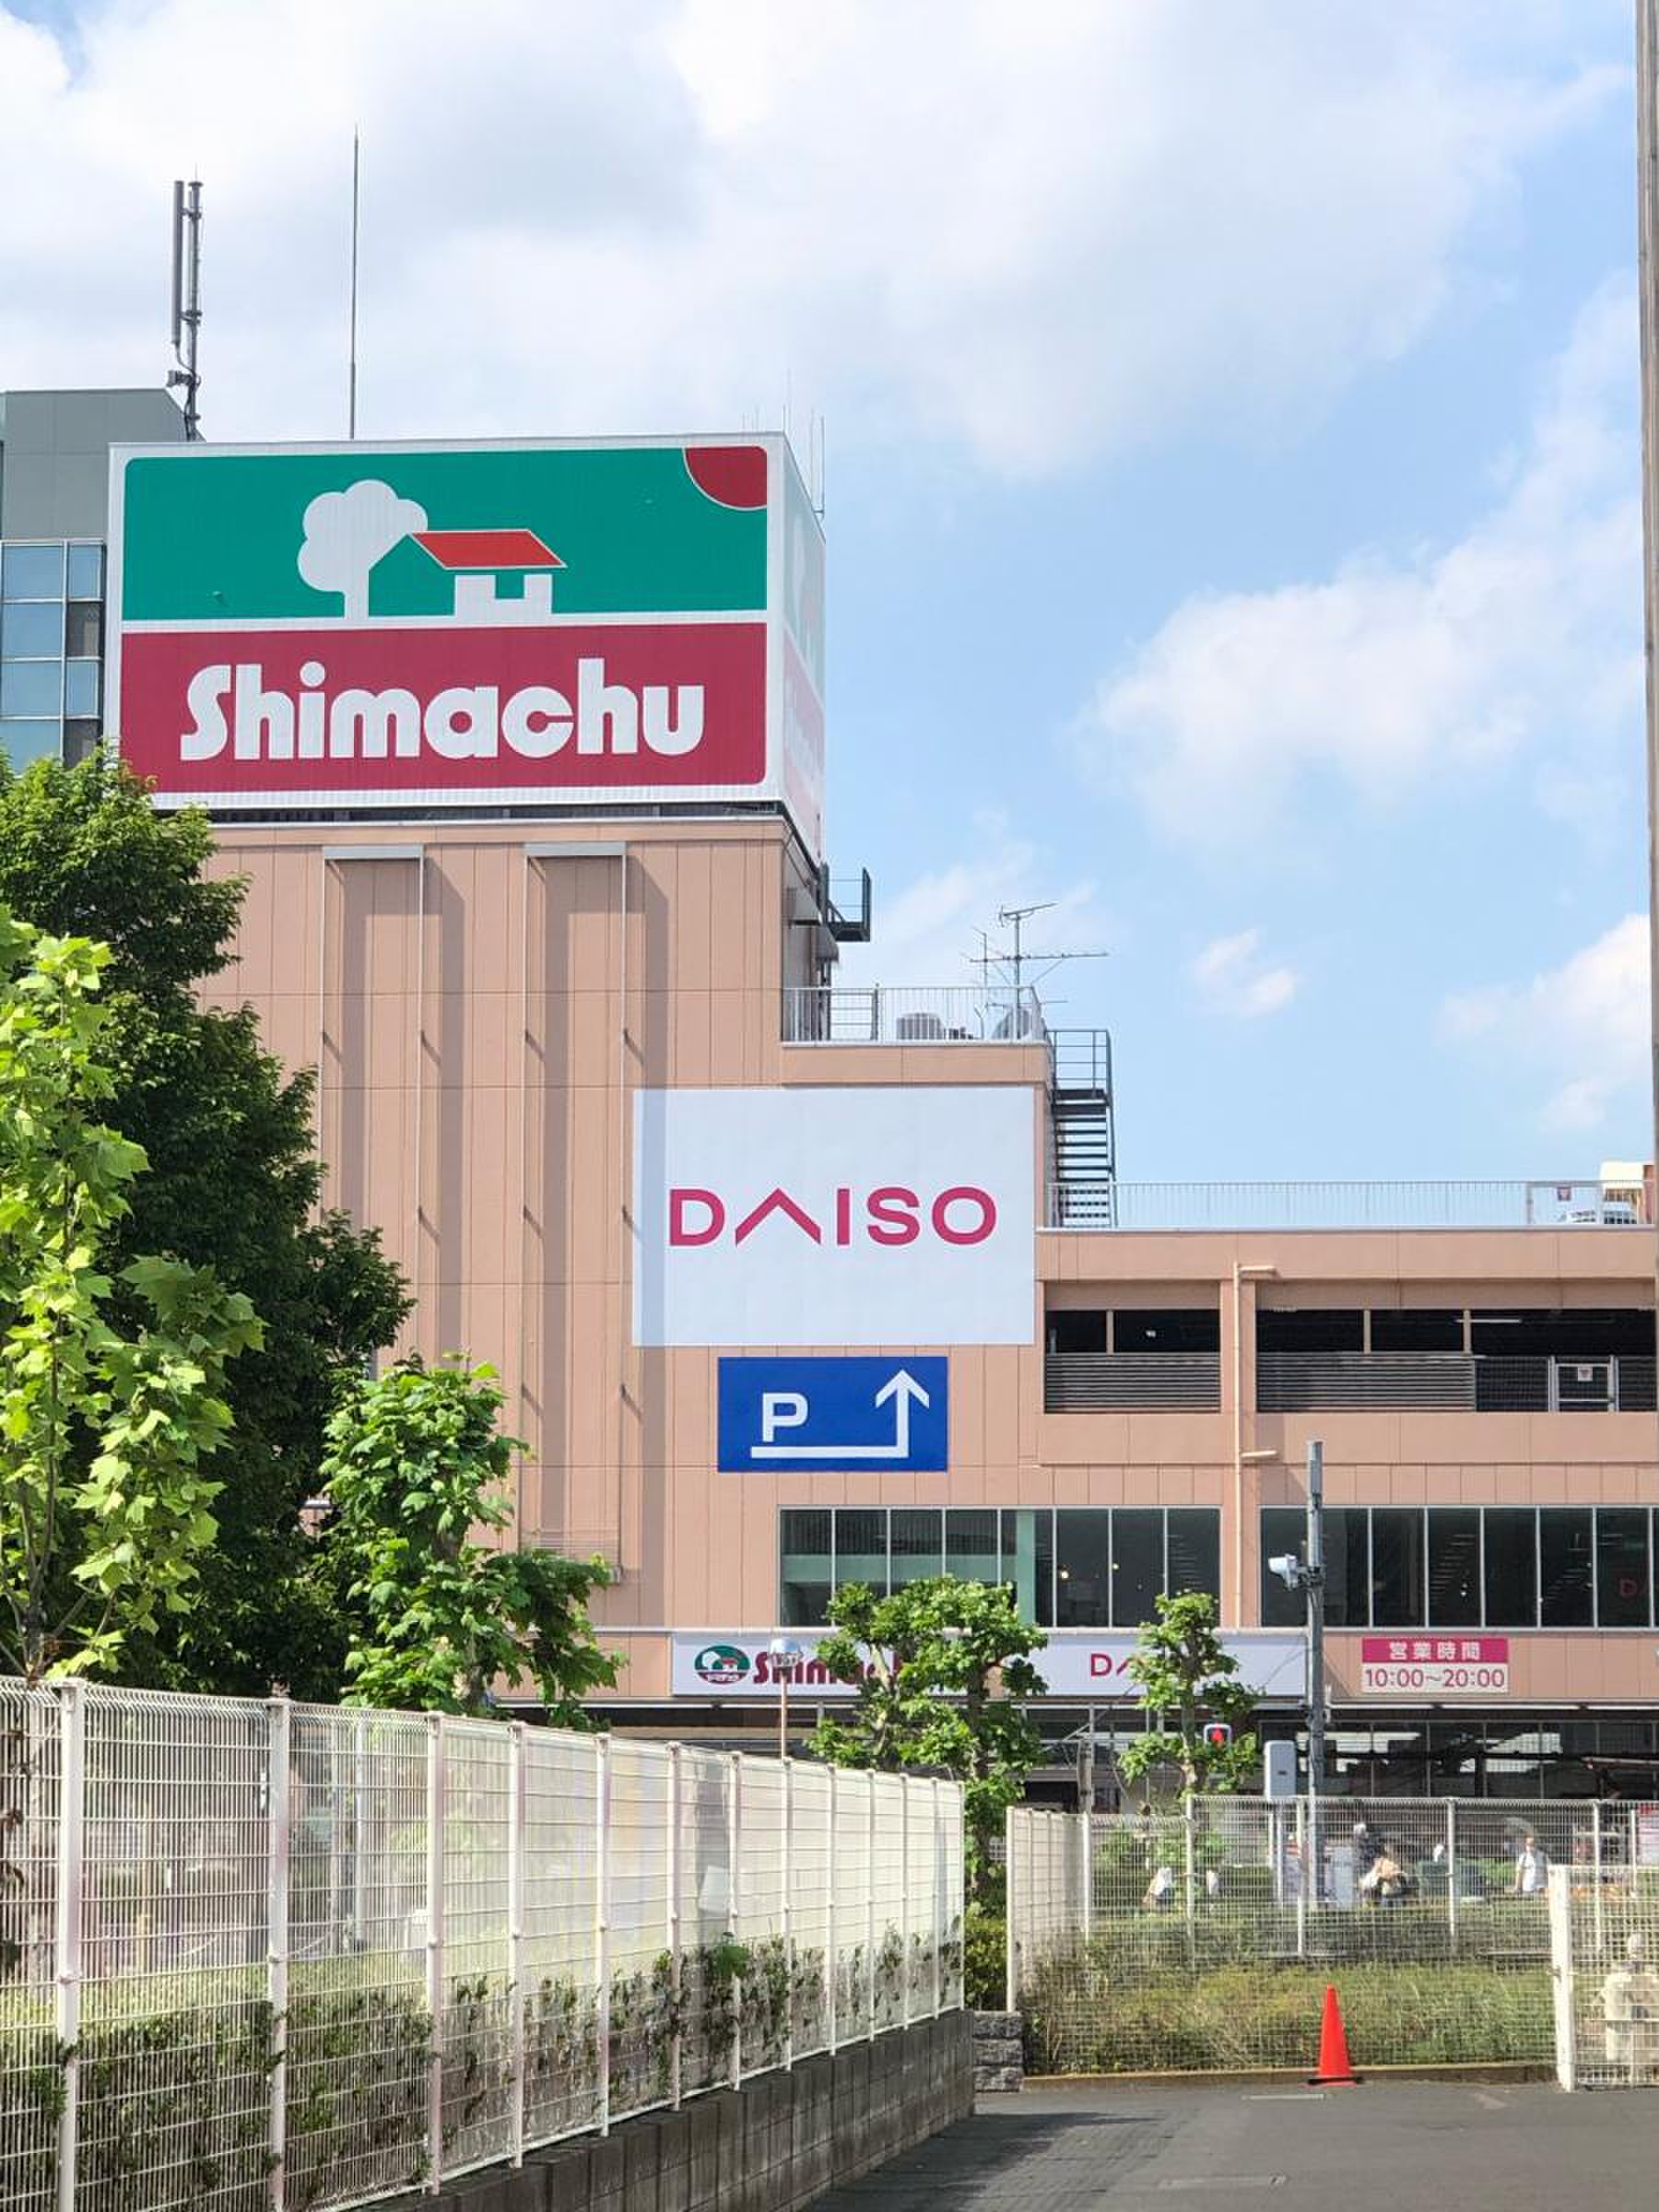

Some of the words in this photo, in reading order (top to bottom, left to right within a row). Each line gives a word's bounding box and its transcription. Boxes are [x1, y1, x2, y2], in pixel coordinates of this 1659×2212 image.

[181, 657, 705, 761] Shimachu
[670, 1186, 997, 1246] DAISO
[762, 1393, 808, 1442] P
[1388, 1641, 1480, 1661] 営業時間
